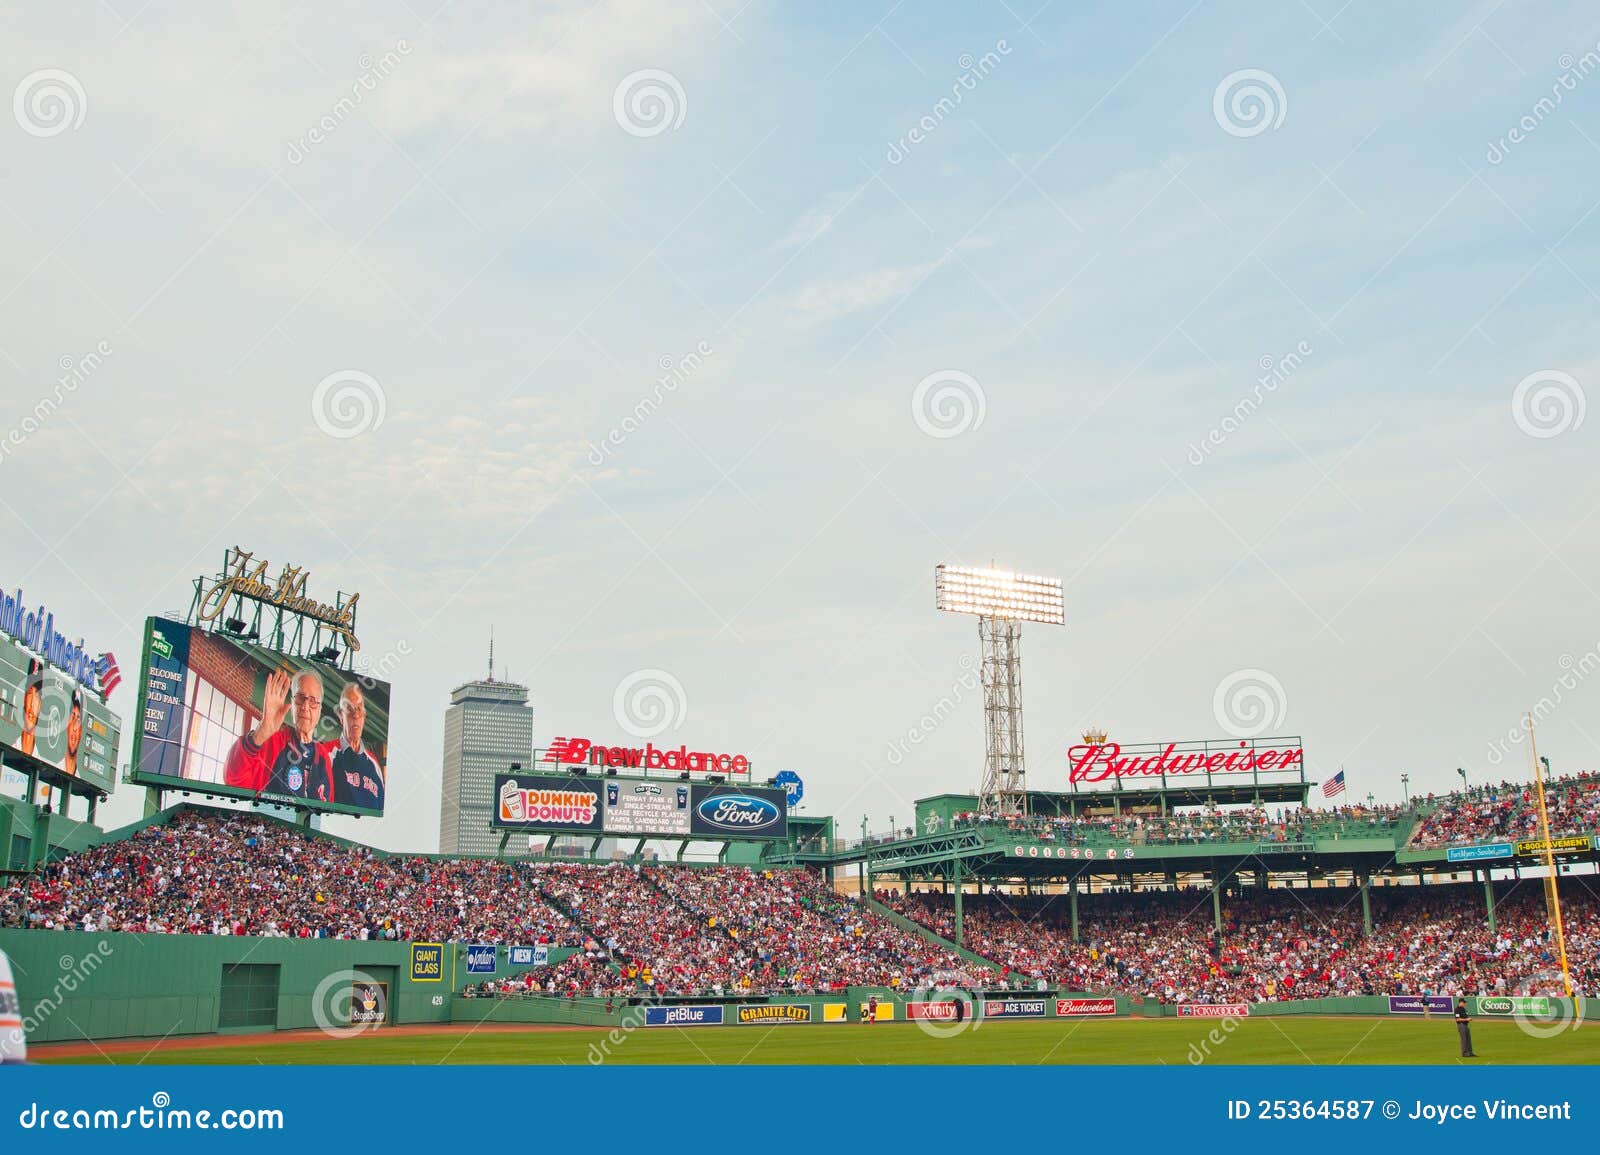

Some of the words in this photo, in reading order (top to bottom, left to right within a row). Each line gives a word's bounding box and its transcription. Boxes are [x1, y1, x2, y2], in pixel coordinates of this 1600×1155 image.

[199, 545, 272, 621] John
[271, 562, 360, 651] Hancock
[25, 605, 45, 652] of
[39, 612, 97, 690] America
[591, 744, 643, 768] new
[646, 742, 748, 774] balance
[1067, 740, 1304, 784] Budweiser
[527, 791, 596, 808] DUNKIN'
[527, 806, 592, 822] DONUTS
[713, 800, 764, 824] Ford
[416, 950, 438, 961] GIANT
[415, 963, 438, 975] GLASS
[432, 996, 443, 1005] 420
[1005, 1003, 1019, 1012] ACE
[1020, 1002, 1043, 1012] TICKET
[1059, 1000, 1114, 1013] Budweiser
[1484, 1000, 1510, 1010] Scotts
[665, 1008, 704, 1023] jetBlue
[740, 1006, 785, 1022] GRANITE
[786, 1005, 808, 1020] CITY
